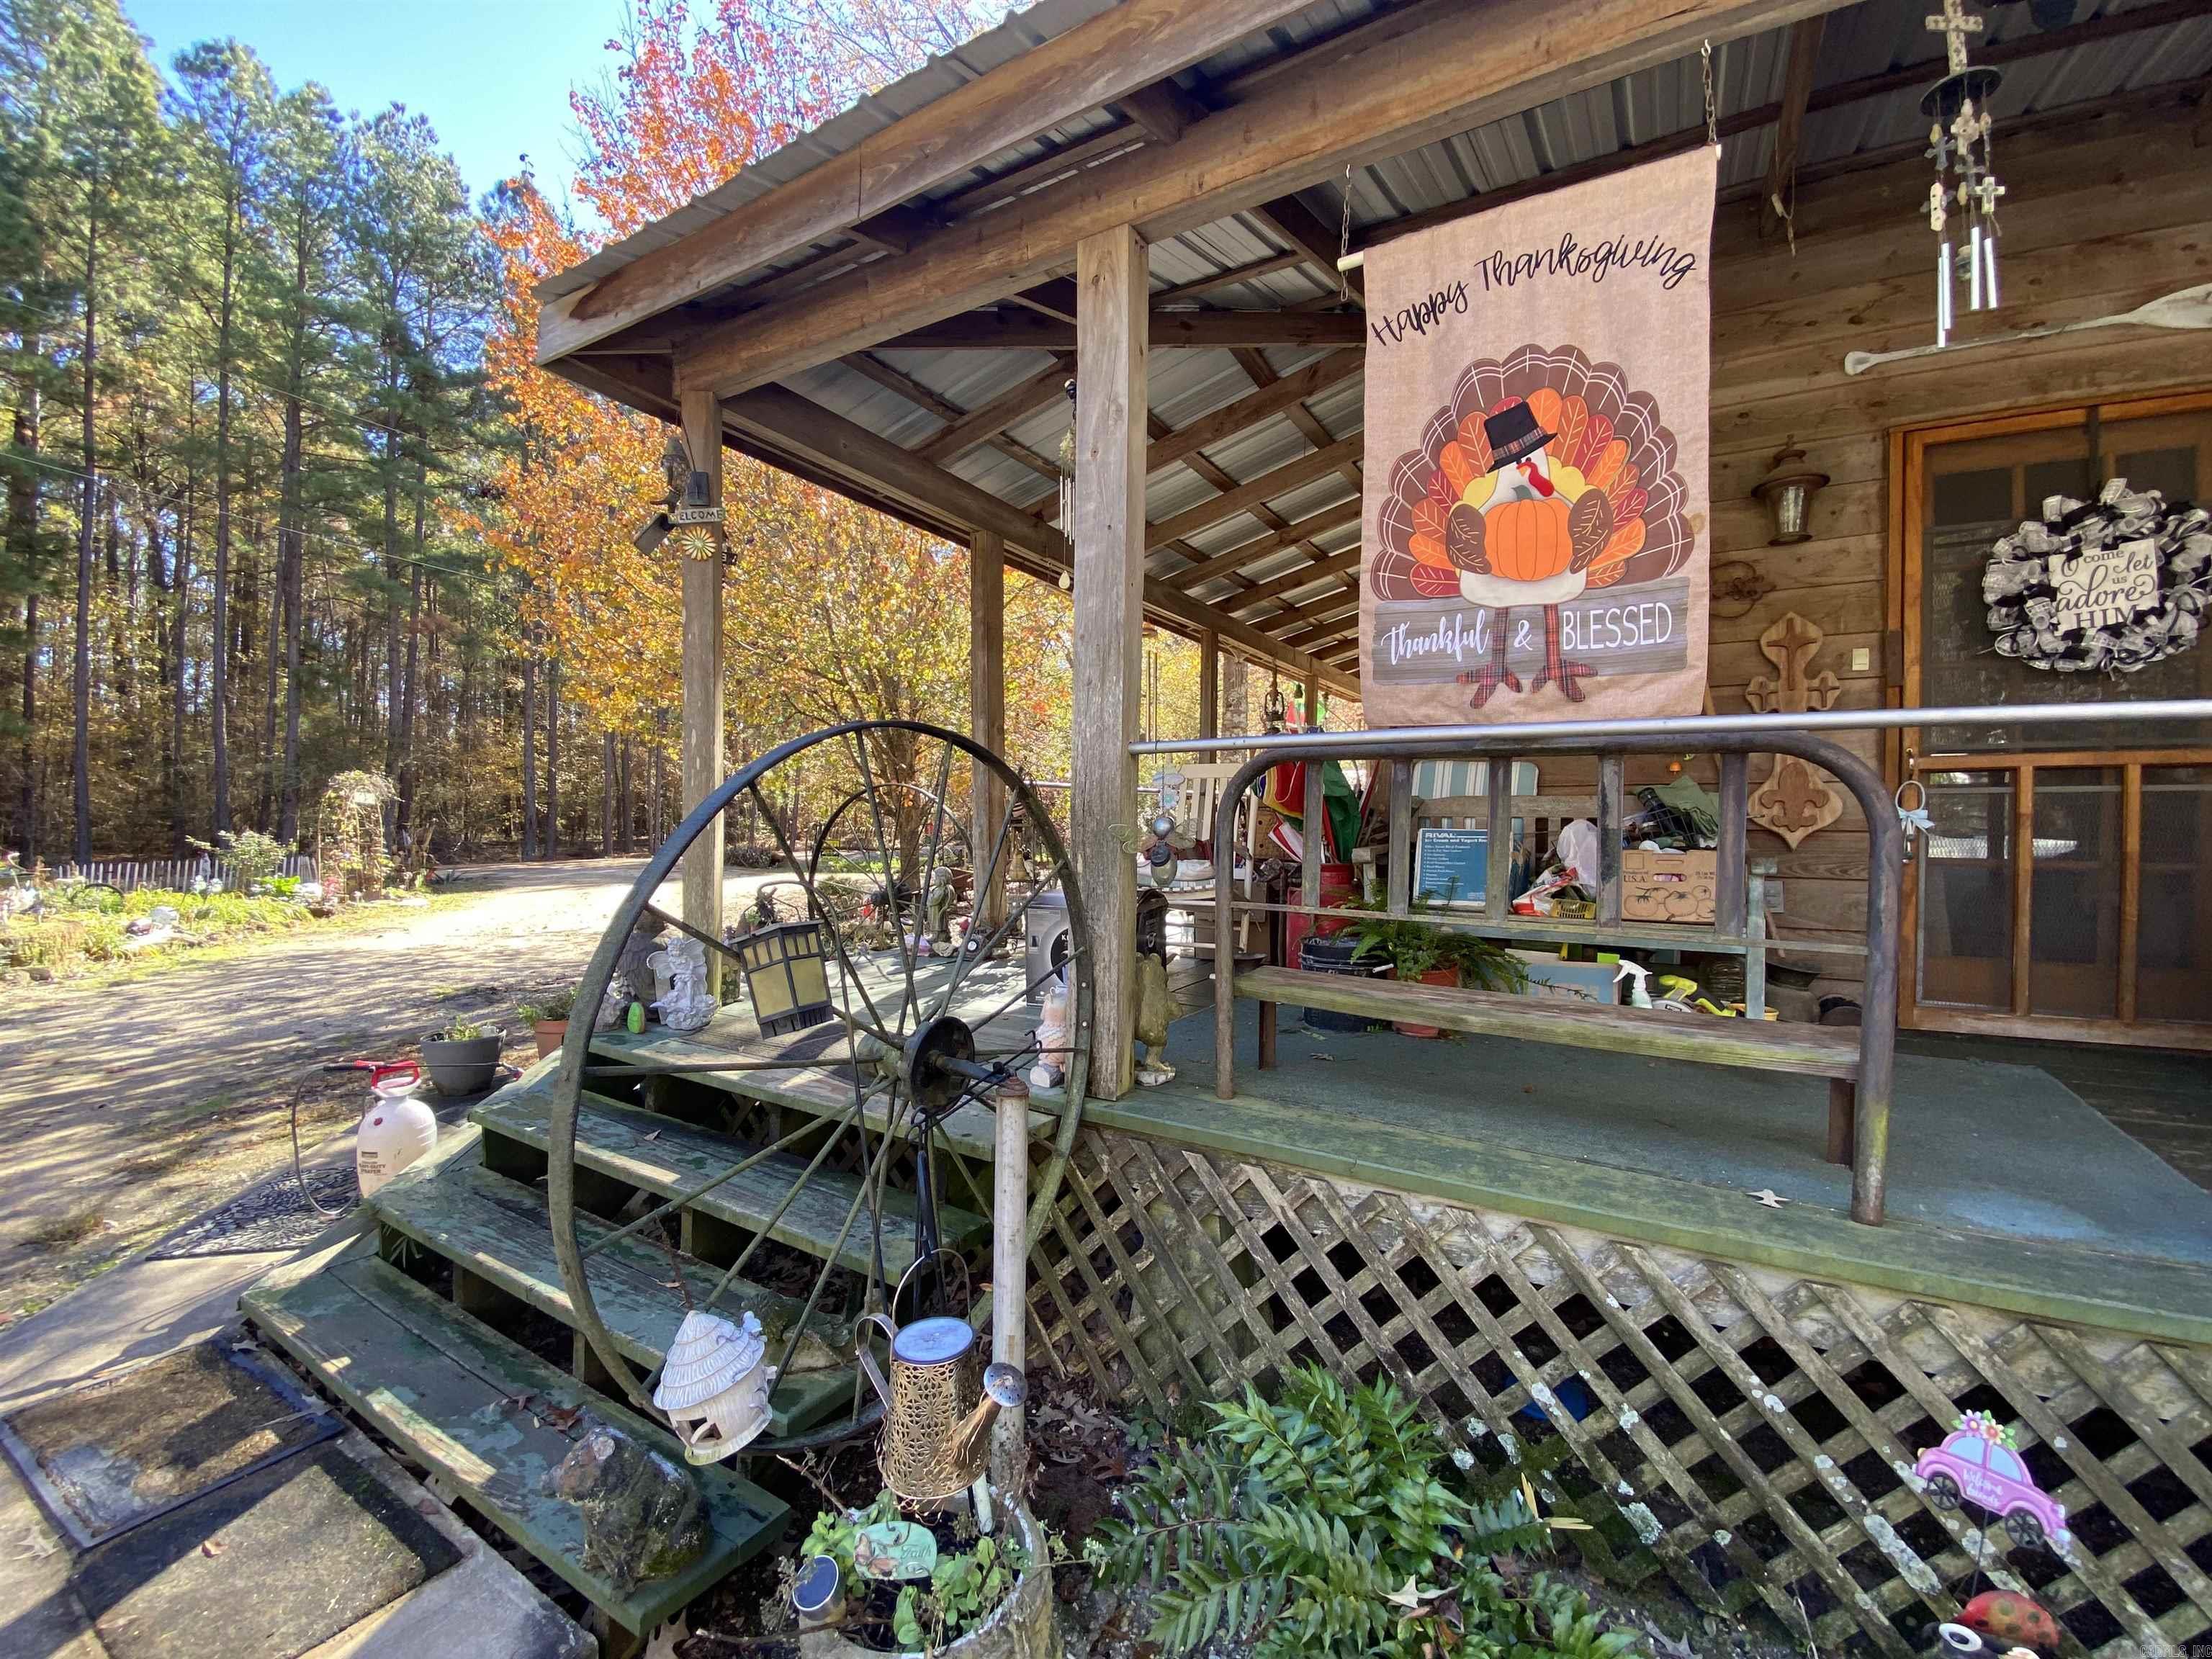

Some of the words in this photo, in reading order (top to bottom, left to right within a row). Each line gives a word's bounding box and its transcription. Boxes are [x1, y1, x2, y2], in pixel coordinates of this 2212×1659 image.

[1371, 280, 1469, 346] Happy
[1474, 232, 1696, 291] Thanksgiving
[678, 509, 723, 521] ELCOME
[2084, 550, 2125, 564] come
[2113, 552, 2154, 573] let
[2055, 564, 2155, 613] adore
[2112, 575, 2128, 585] us
[1514, 619, 1533, 651] &
[1563, 602, 1672, 651] BLESSED
[2074, 603, 2140, 629] HIM
